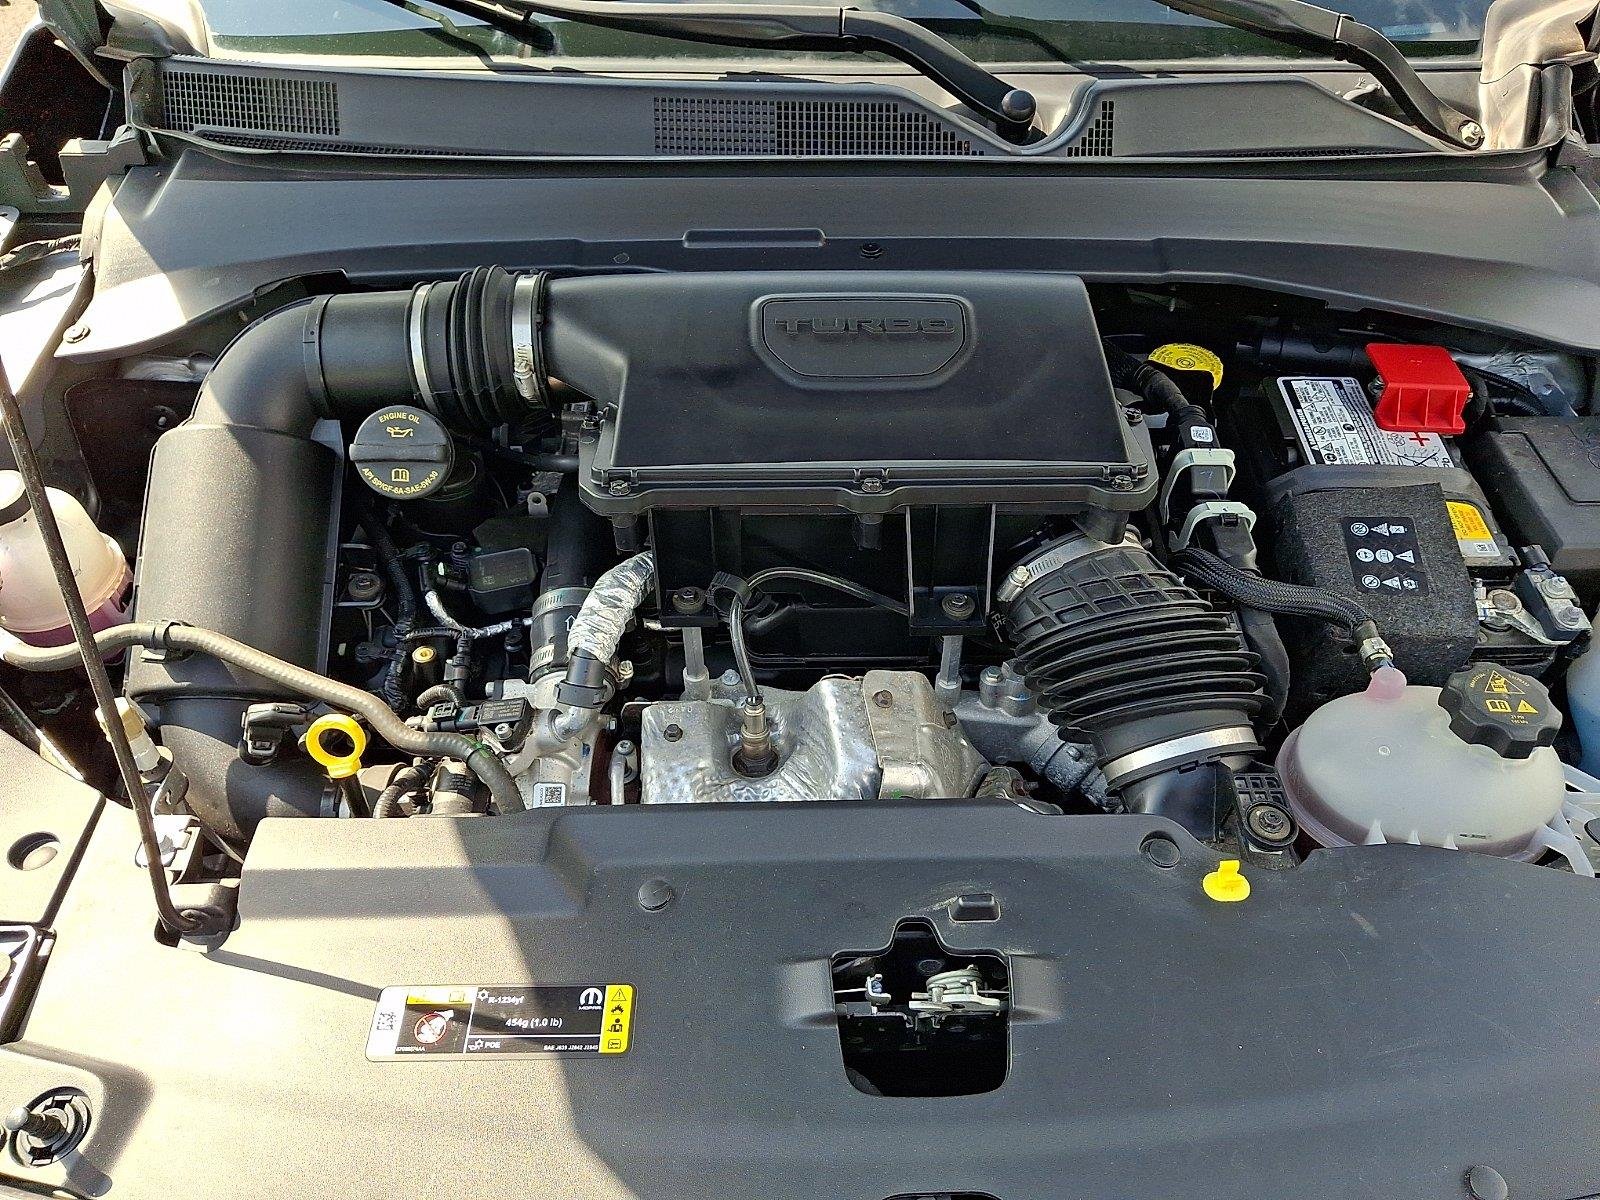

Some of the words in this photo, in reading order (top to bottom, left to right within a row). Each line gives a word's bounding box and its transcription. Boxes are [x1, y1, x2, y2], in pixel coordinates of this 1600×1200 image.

[774, 317, 955, 335] TURBO
[378, 412, 407, 424] ENGINE
[408, 413, 420, 424] OIL
[362, 468, 374, 481] API
[487, 996, 524, 1005] R-1234yf
[505, 1018, 529, 1028] 454g
[530, 1017, 549, 1028] (1.0
[550, 1017, 563, 1028] lb)
[484, 1041, 501, 1050] POE
